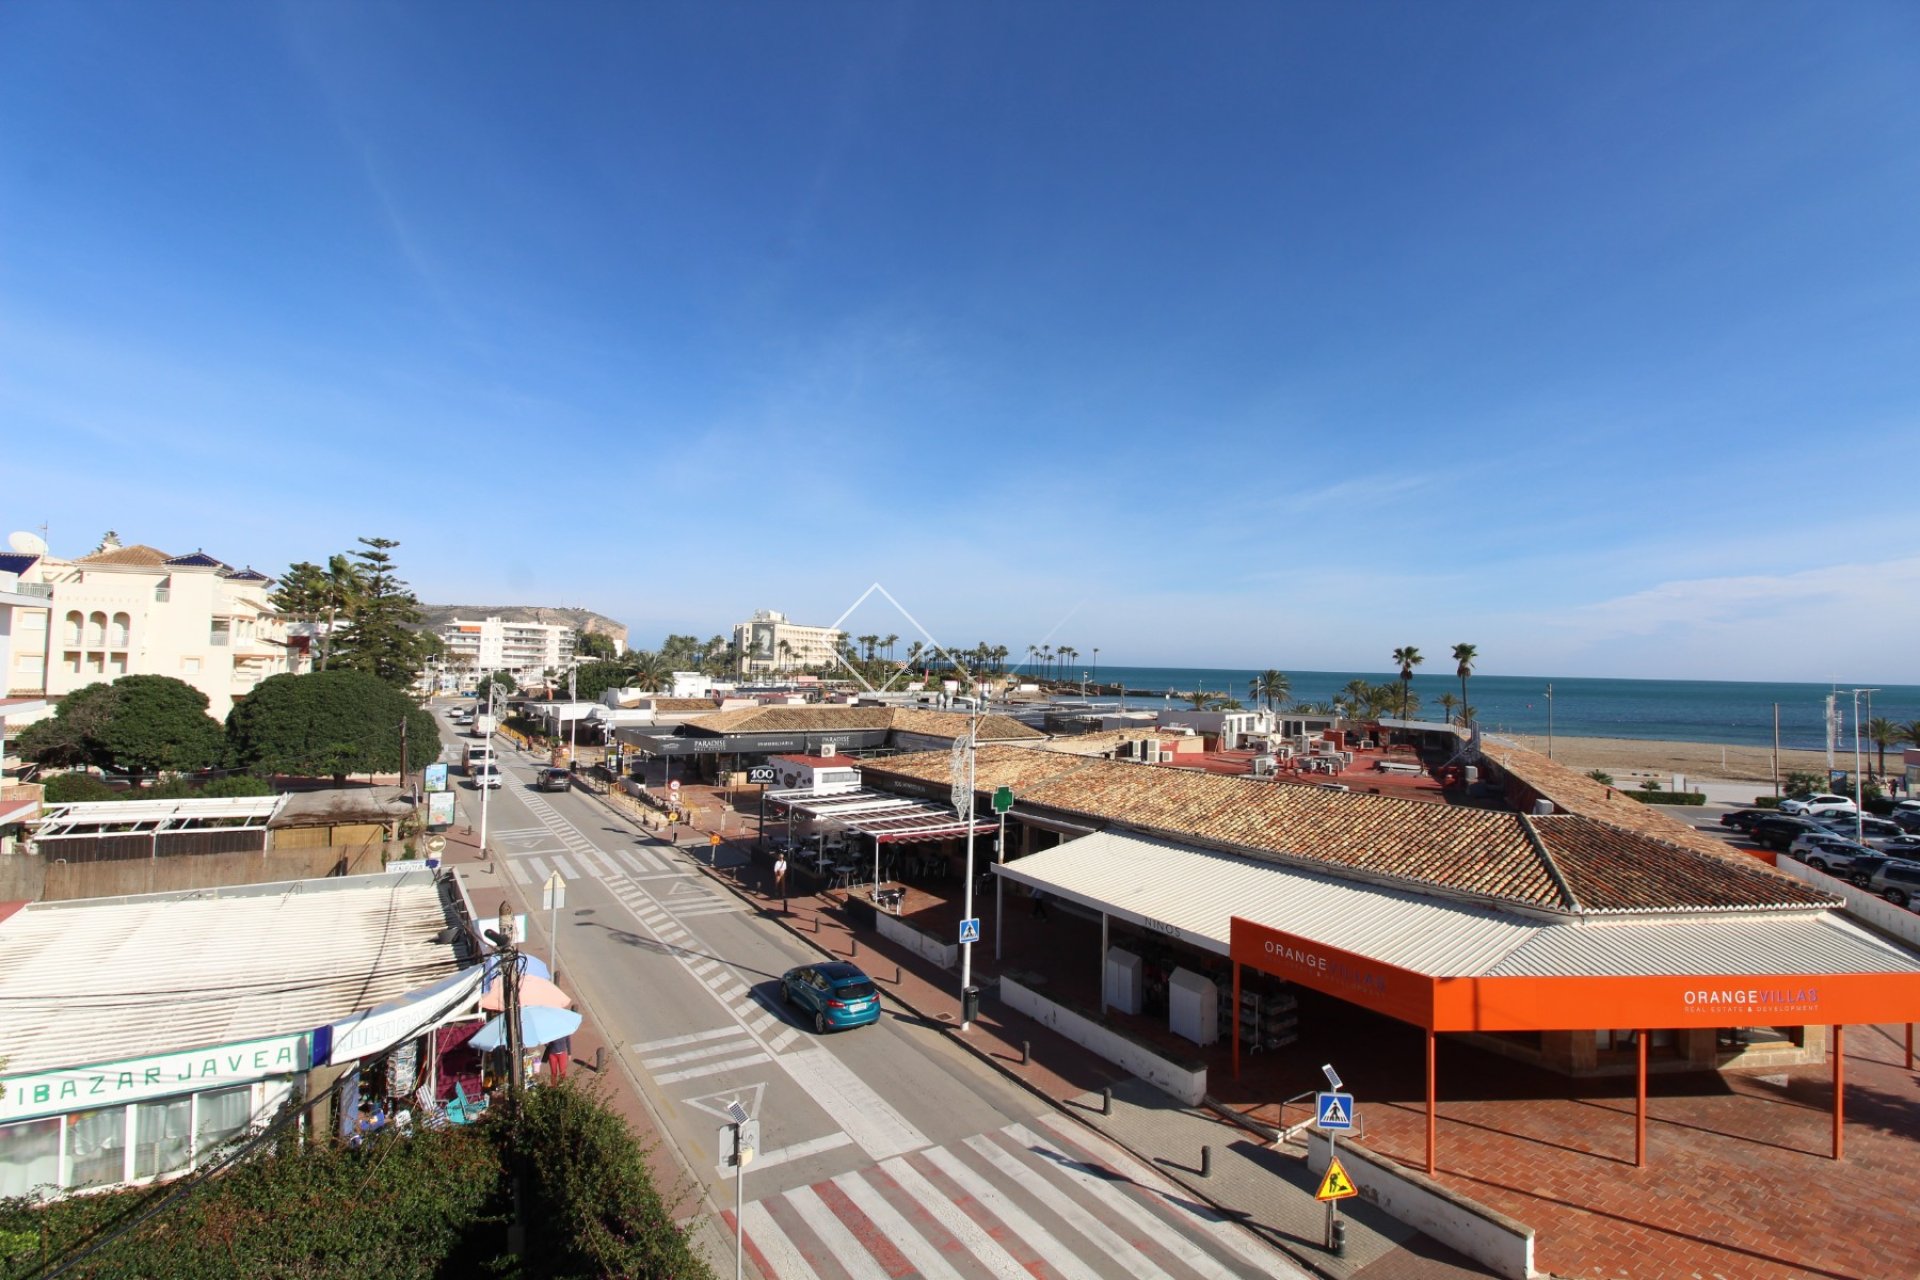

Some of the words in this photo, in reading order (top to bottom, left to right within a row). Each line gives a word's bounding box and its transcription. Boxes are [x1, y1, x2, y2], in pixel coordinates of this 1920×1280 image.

[694, 739, 726, 748] PARADISE
[750, 769, 774, 779] 100
[178, 1046, 292, 1081] JAVEA
